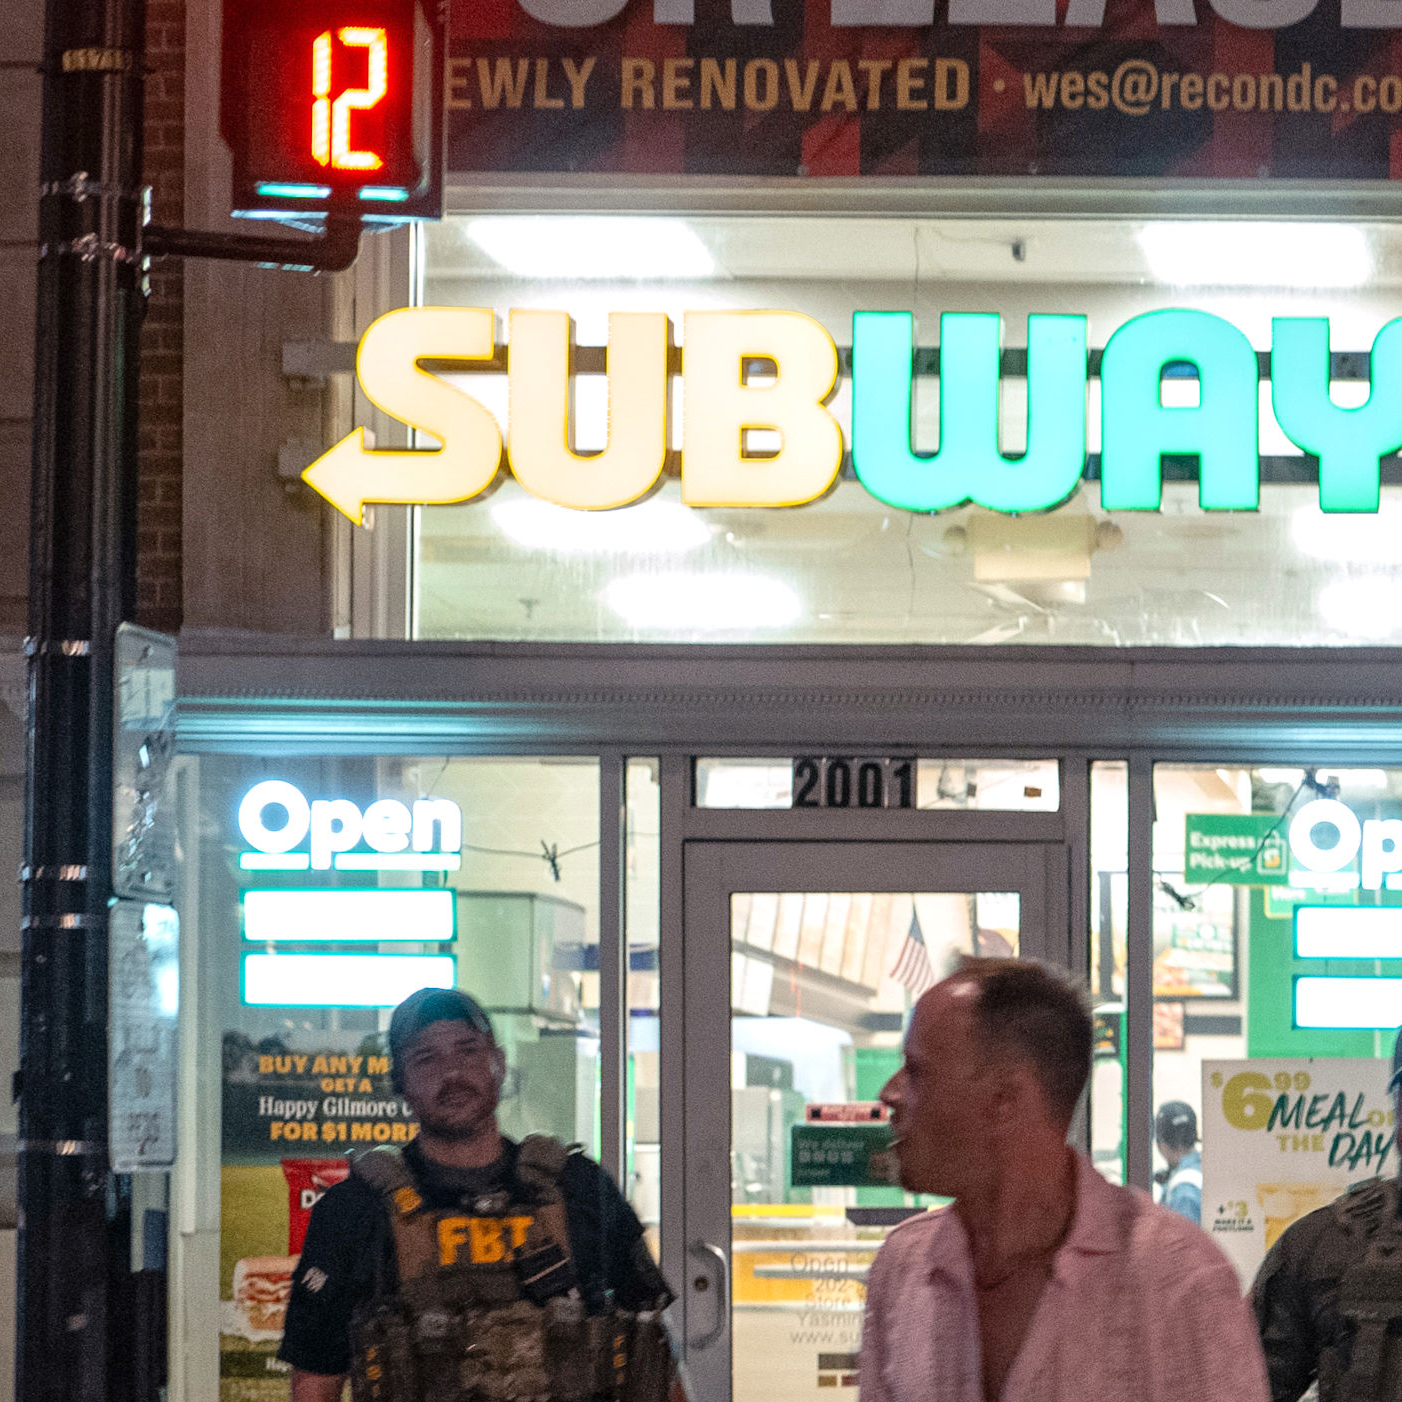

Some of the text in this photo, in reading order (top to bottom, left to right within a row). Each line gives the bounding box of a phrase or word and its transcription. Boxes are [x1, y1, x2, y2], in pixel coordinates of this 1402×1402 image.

[311, 27, 387, 170] 12
[445, 57, 596, 111] EWLY
[621, 57, 970, 112] RENOVATED
[797, 757, 913, 808] 2001
[238, 780, 462, 870] Open
[1189, 832, 1256, 850] Express
[258, 1055, 307, 1074] BUY
[311, 1055, 363, 1074] ANY
[320, 1078, 373, 1093] GET A
[258, 1096, 319, 1120] Happy
[322, 1096, 398, 1117] Gilmore
[1266, 1090, 1370, 1133] MEAL
[270, 1121, 318, 1141] FOR
[321, 1121, 348, 1143] $1
[1276, 1130, 1398, 1174] THE DAY
[438, 1215, 534, 1267] FBI
[790, 1252, 848, 1276] Open
[789, 1330, 860, 1344] www.su
